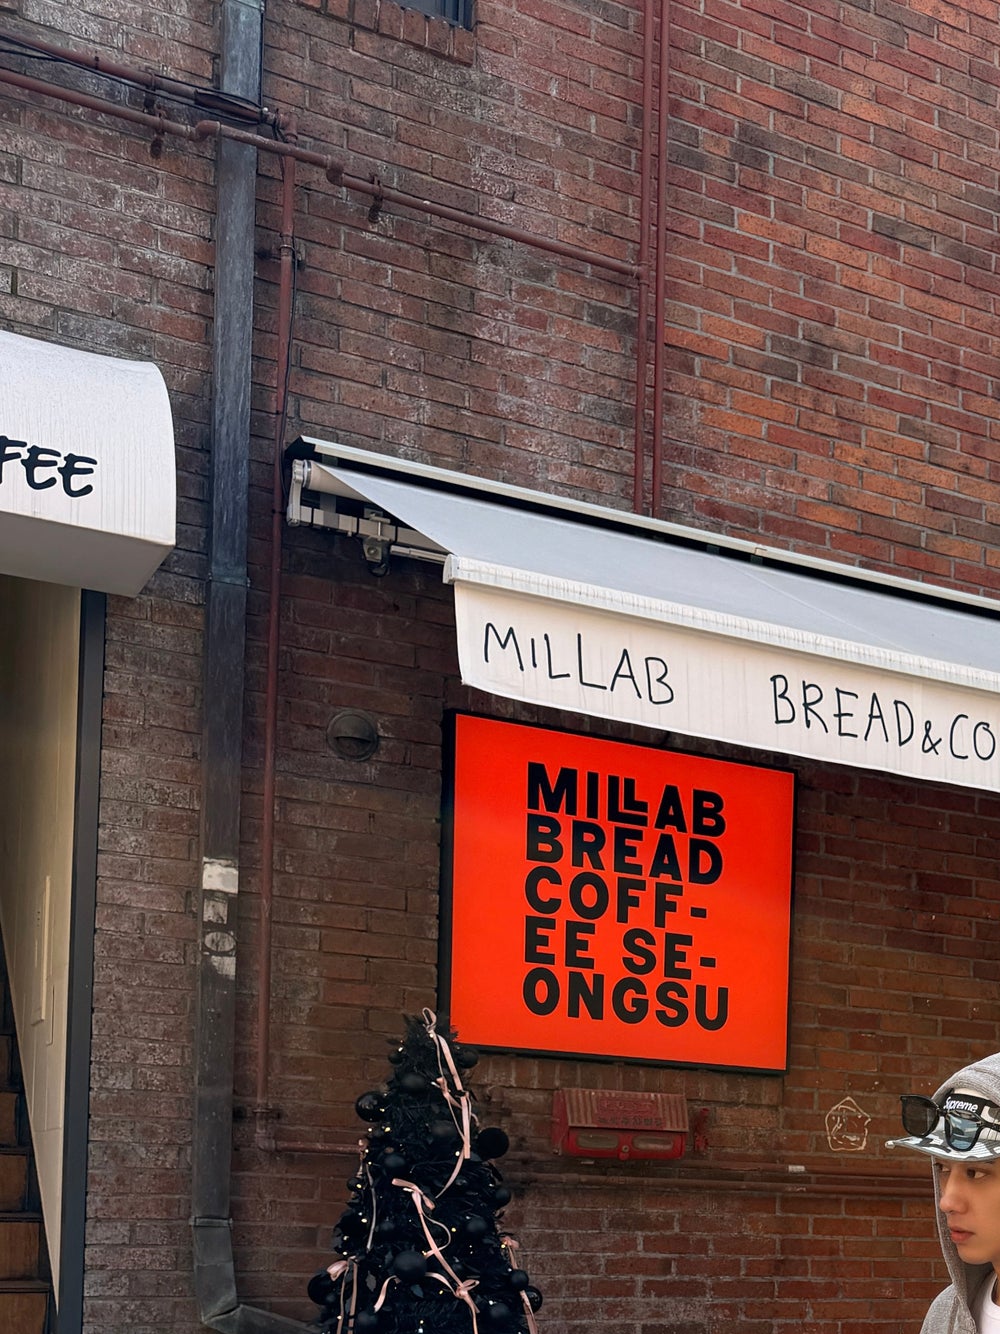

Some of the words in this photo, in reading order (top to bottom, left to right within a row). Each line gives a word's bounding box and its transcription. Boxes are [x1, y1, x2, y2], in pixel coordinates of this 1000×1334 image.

[483, 622, 675, 705] MILLAB
[527, 761, 727, 838] MILLAB
[526, 812, 724, 885] BREAD
[524, 865, 707, 929] COFF-
[524, 915, 596, 970] EE
[622, 927, 717, 981] SE-
[522, 967, 729, 1032] ONGSU
[943, 1096, 979, 1113] Supreme
